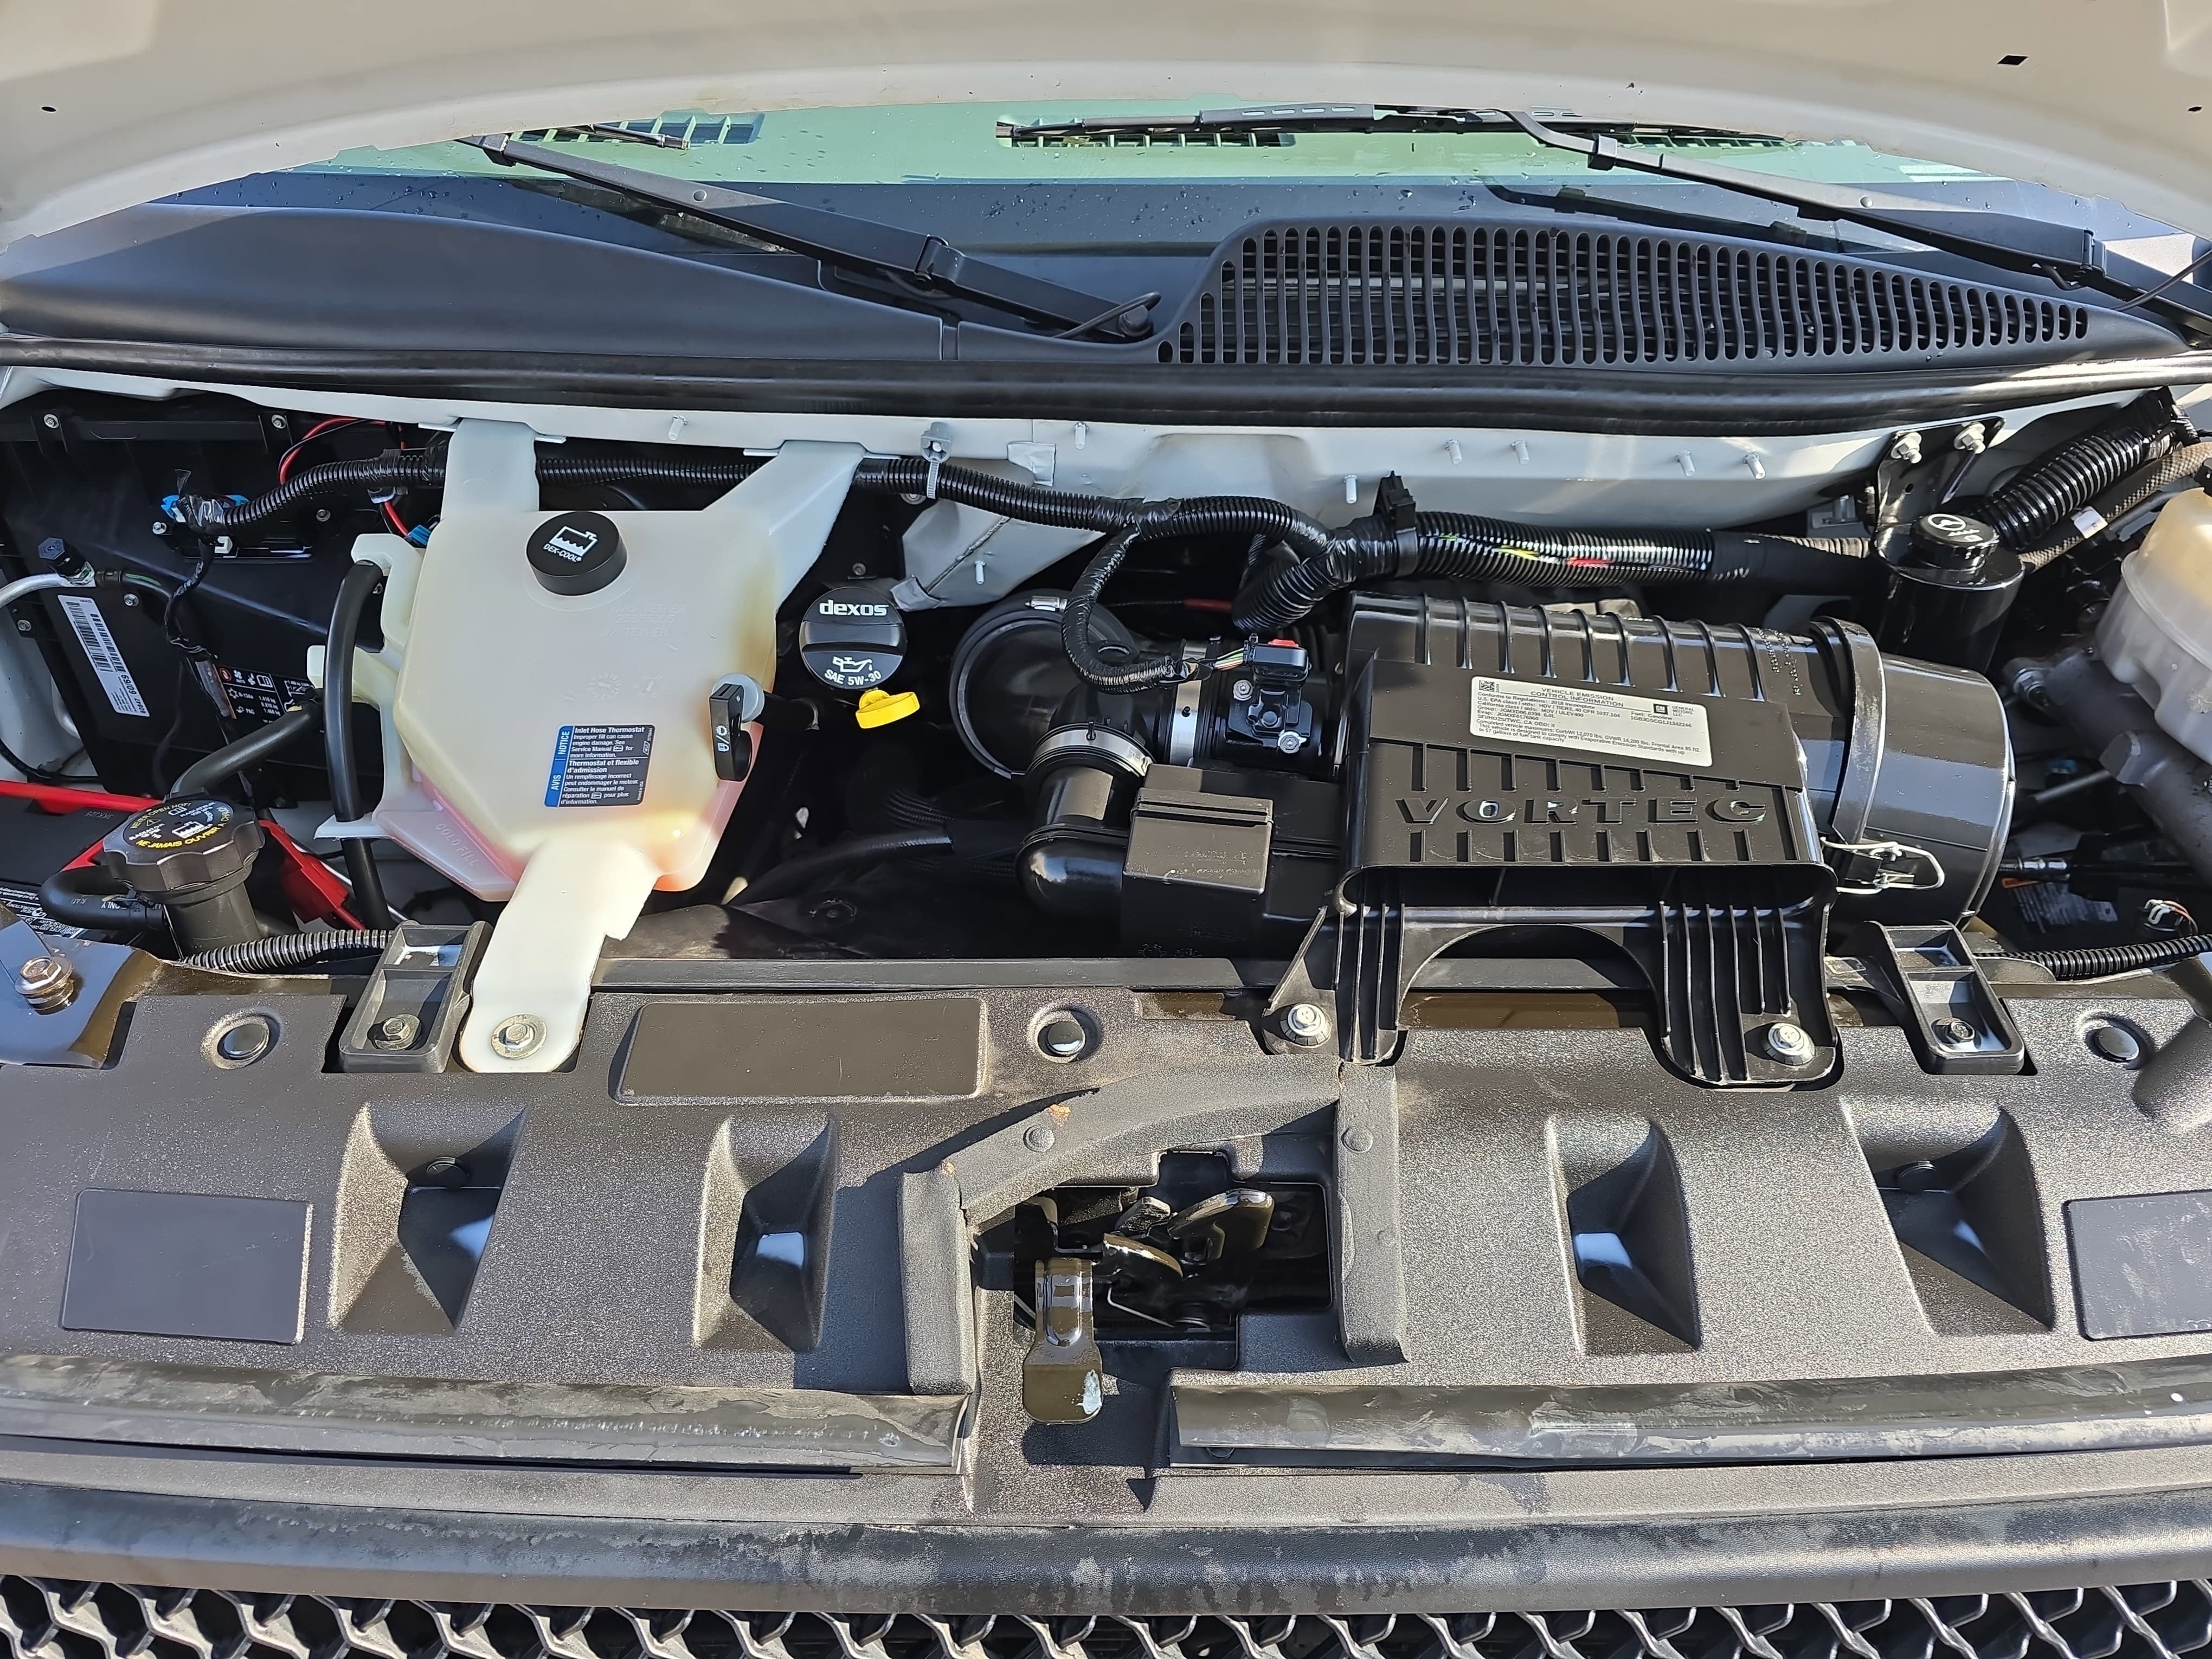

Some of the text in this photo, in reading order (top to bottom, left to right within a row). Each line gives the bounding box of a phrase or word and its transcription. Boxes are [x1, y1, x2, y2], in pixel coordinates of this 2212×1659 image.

[820, 600, 888, 616] dexos
[825, 669, 882, 686] SAE 5W-30
[1531, 691, 1624, 707] CONTROL INFORMATION
[1541, 687, 1614, 700] VEHICLE EMISSION
[558, 731, 570, 755] NOTICE
[551, 774, 561, 790] AVIS
[130, 814, 149, 829] NEVER
[150, 806, 170, 816] OPEN
[180, 802, 216, 818] RADIATEUR
[1396, 798, 1766, 824] VORTEC
[128, 824, 165, 840] RADIATOR
[184, 827, 221, 845] OUVRIR
[435, 823, 479, 866] COLD FILL
